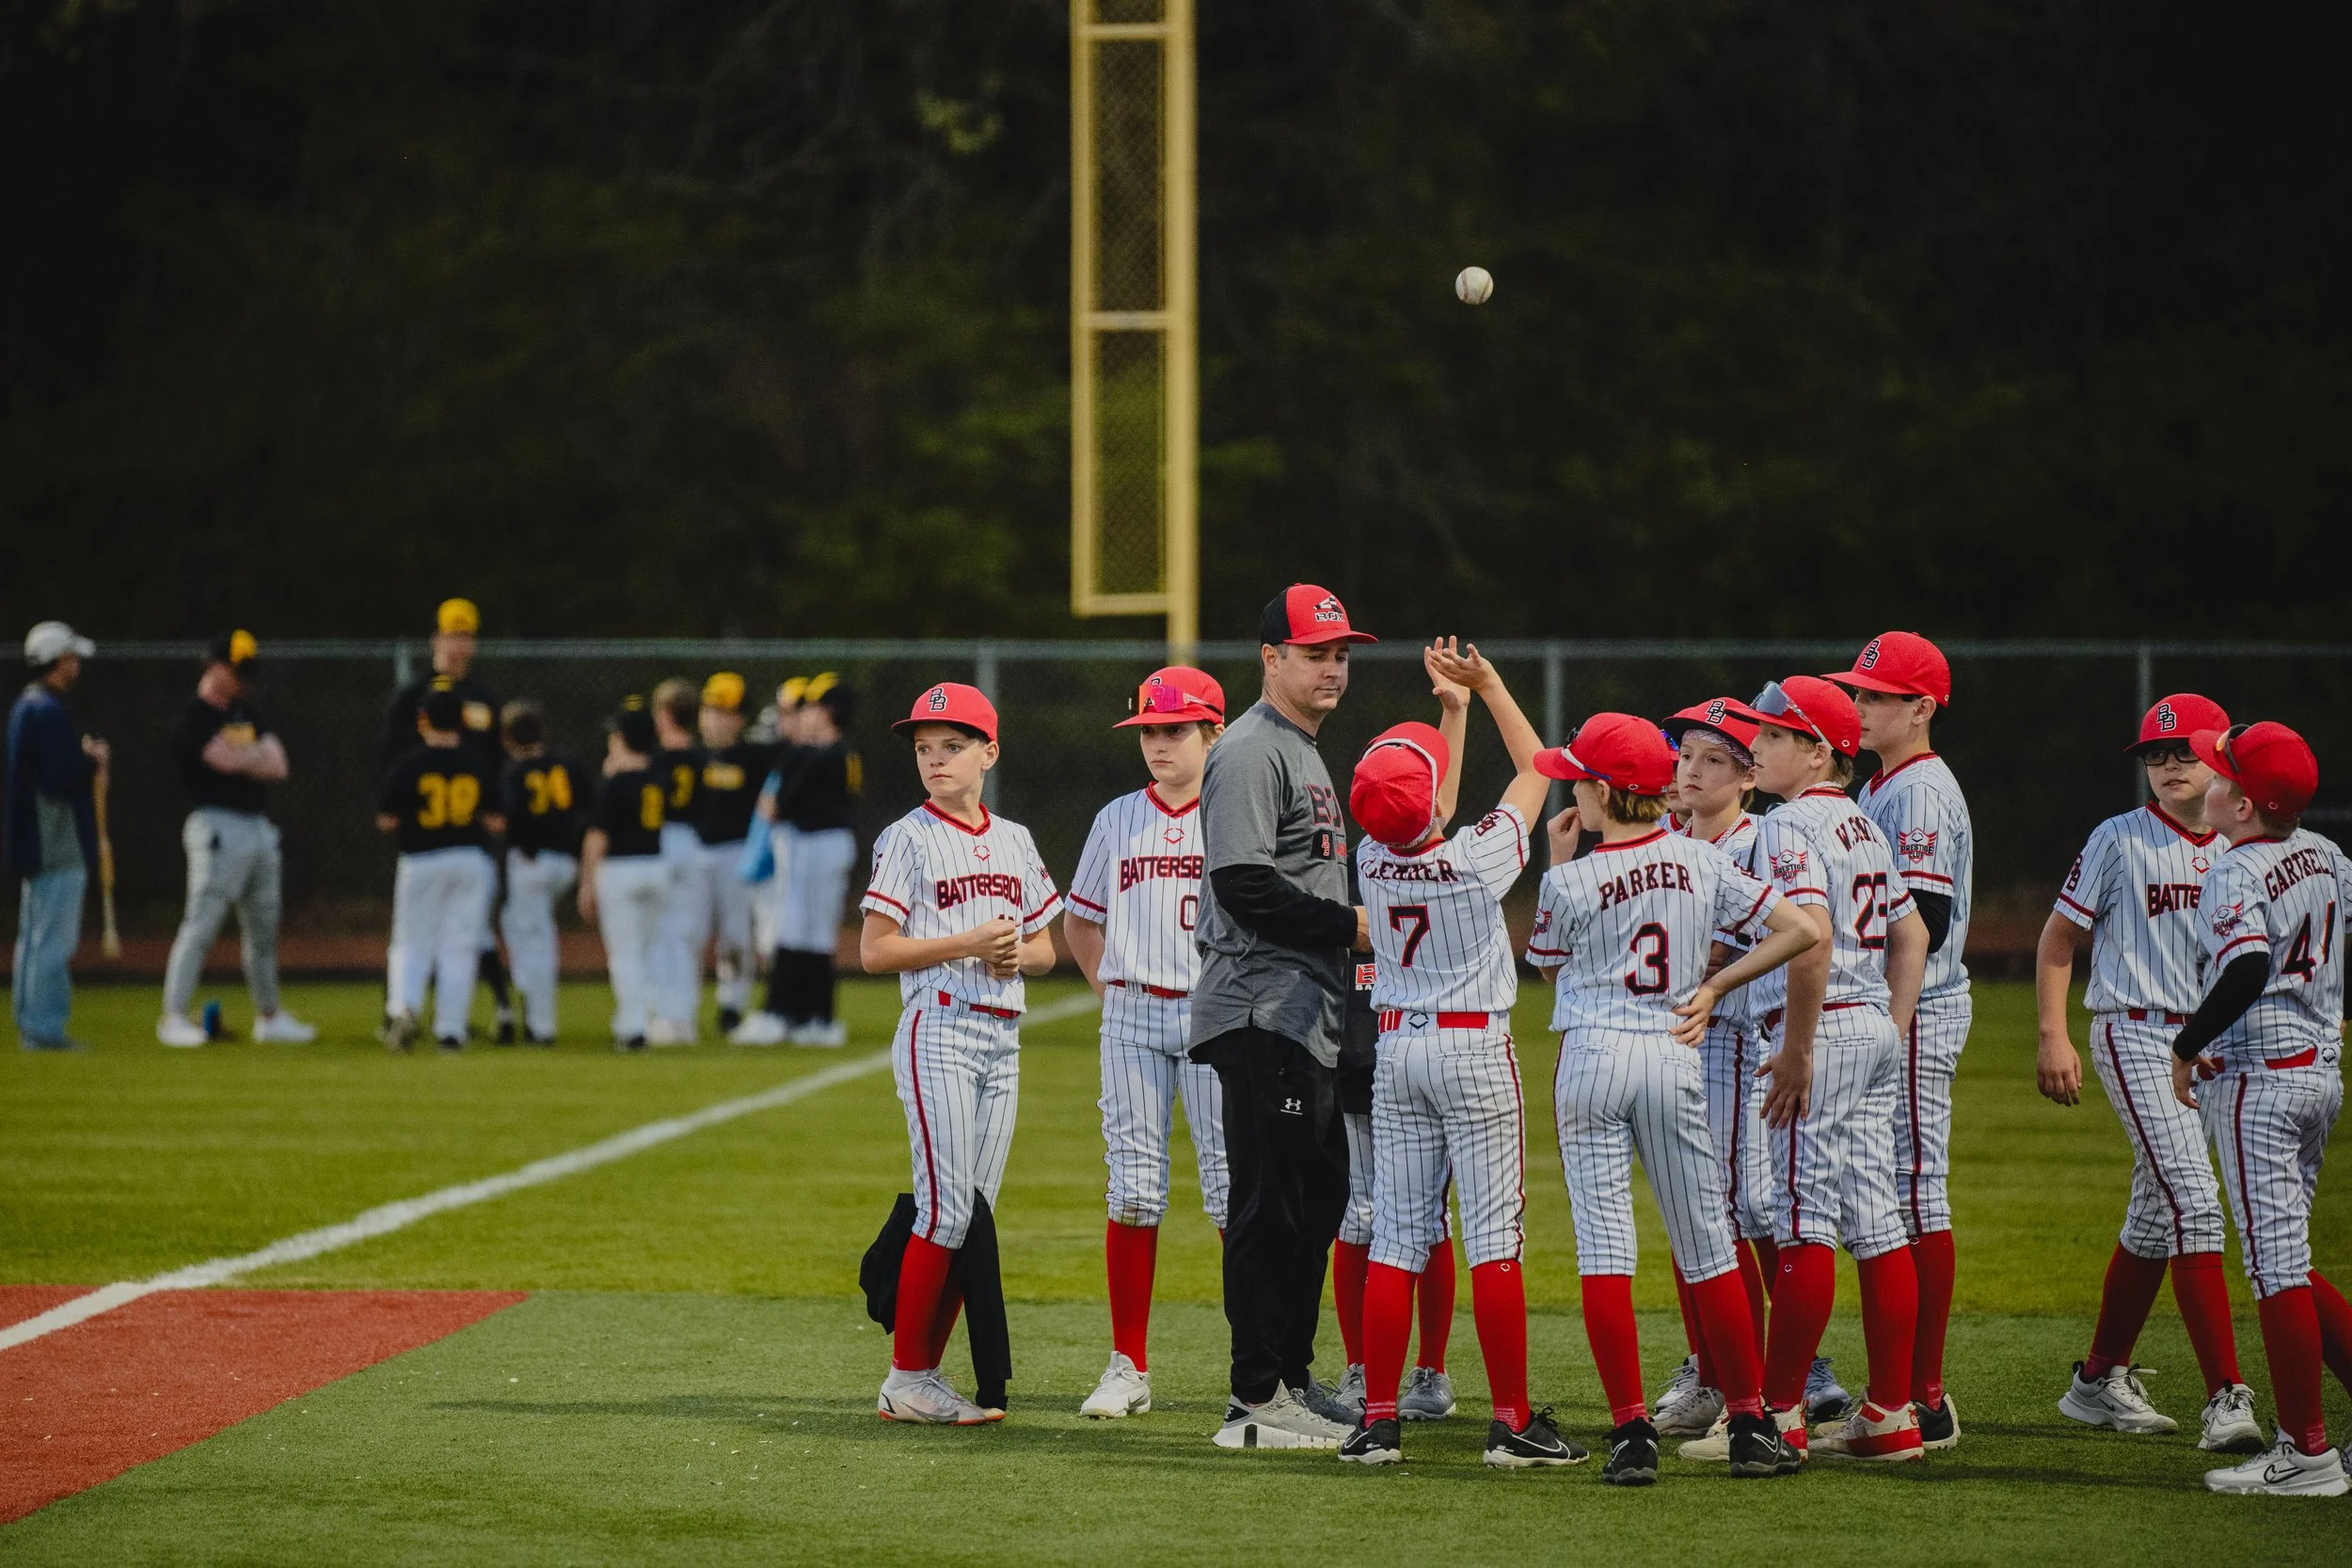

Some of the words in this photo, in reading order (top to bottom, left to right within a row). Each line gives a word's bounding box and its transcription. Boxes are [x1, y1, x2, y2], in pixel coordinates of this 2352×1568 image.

[1860, 639, 1881, 670] BB
[928, 687, 948, 712] BB
[1706, 700, 1727, 725] BB
[2156, 703, 2177, 732] BB
[935, 872, 1024, 911] BATTERSBOX
[1598, 862, 1694, 911] PARKER
[1388, 905, 1430, 968] 7
[1624, 921, 1668, 996] 3
